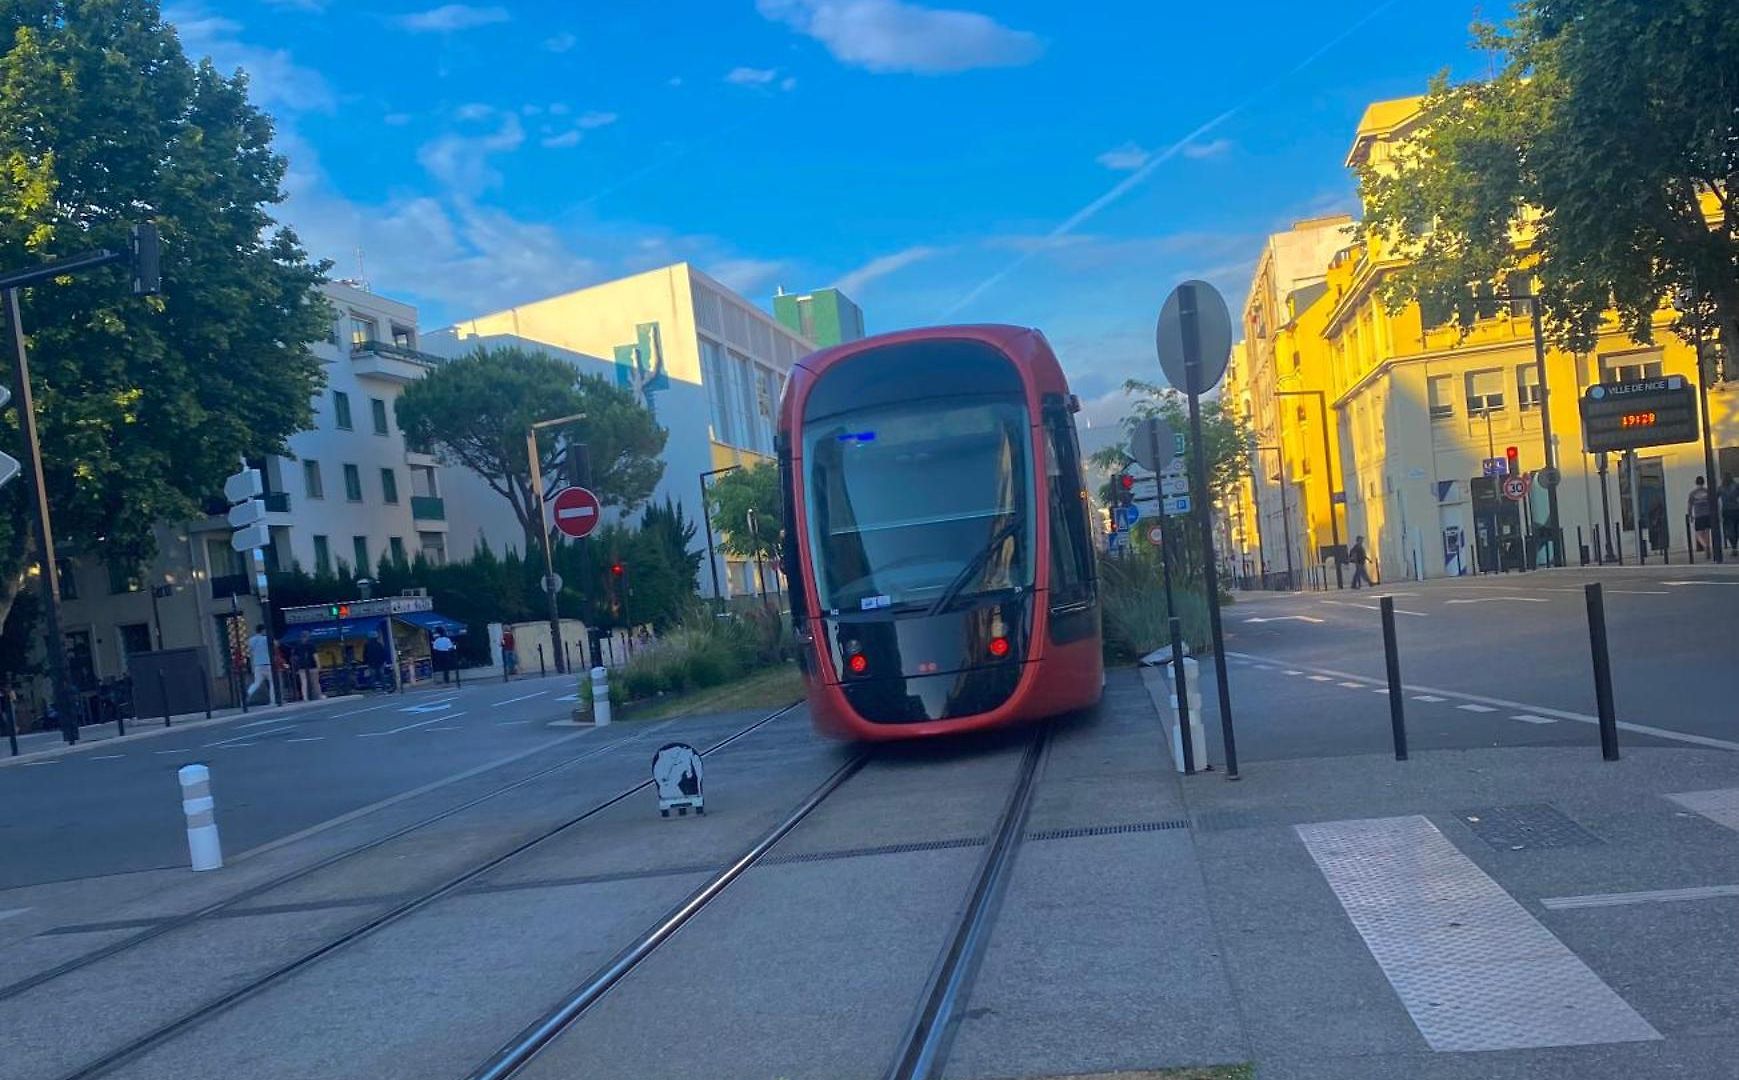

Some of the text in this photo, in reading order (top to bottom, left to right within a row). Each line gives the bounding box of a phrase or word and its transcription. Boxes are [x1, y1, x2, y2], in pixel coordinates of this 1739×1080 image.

[1608, 380, 1665, 395] VILLE DE NICE
[1510, 482, 1524, 493] 30
